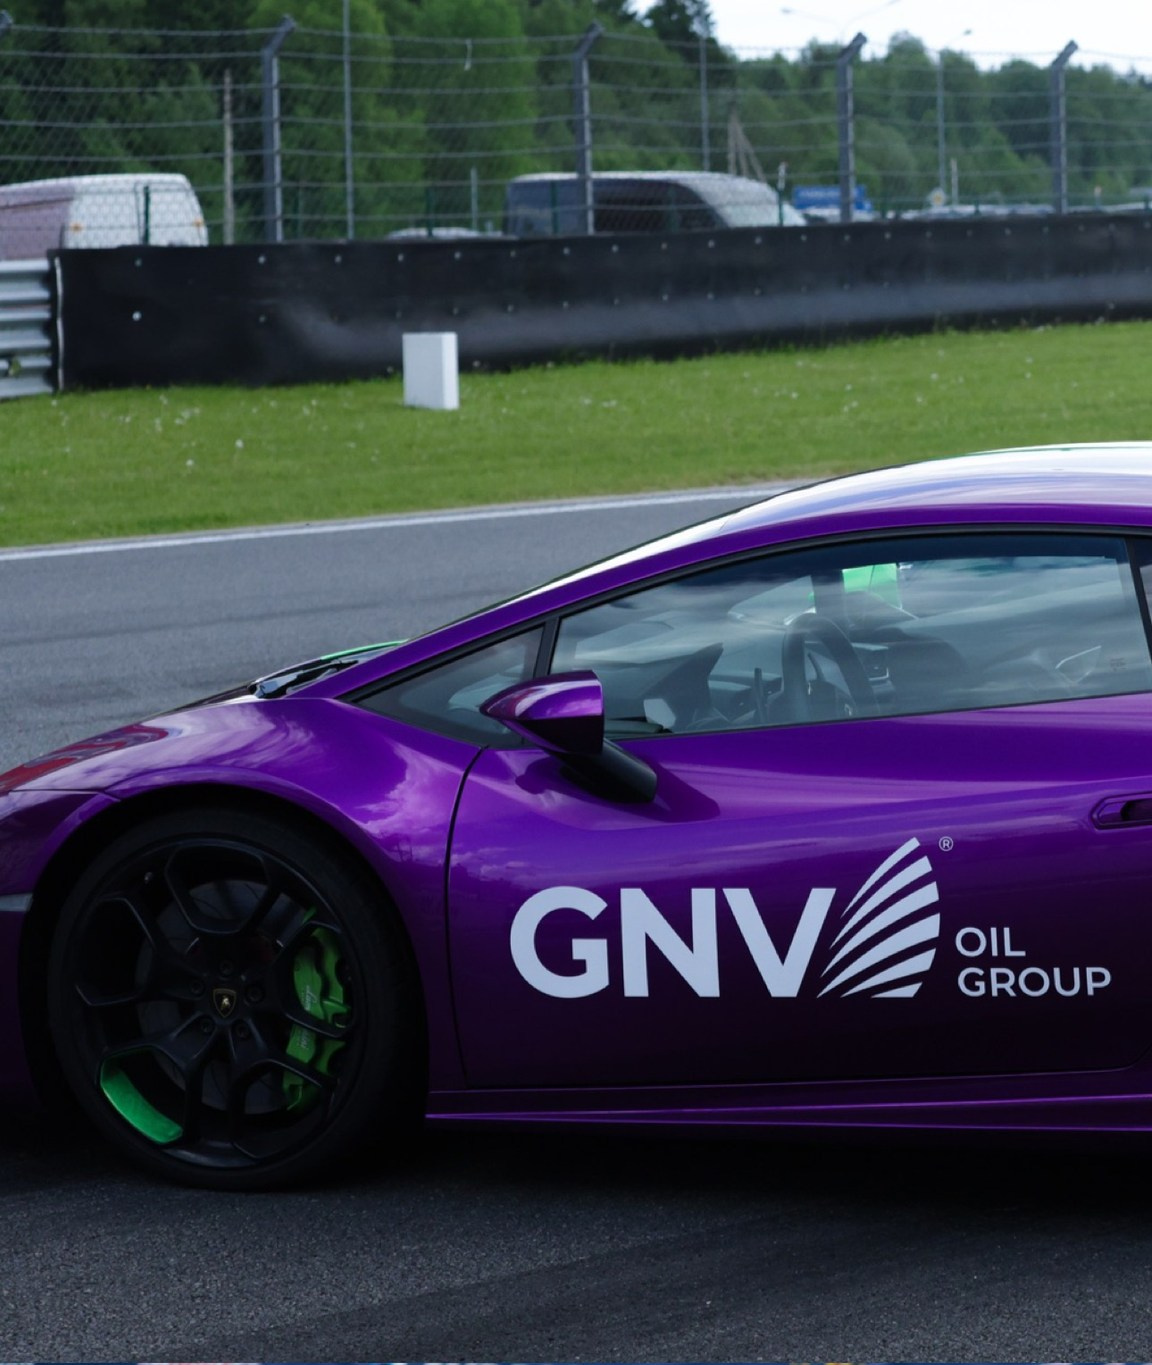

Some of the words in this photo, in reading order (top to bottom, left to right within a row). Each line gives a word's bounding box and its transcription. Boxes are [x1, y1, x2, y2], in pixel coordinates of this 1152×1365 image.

[510, 885, 837, 999] GNV
[955, 926, 1027, 957] OIL
[957, 966, 1112, 997] GROUP
